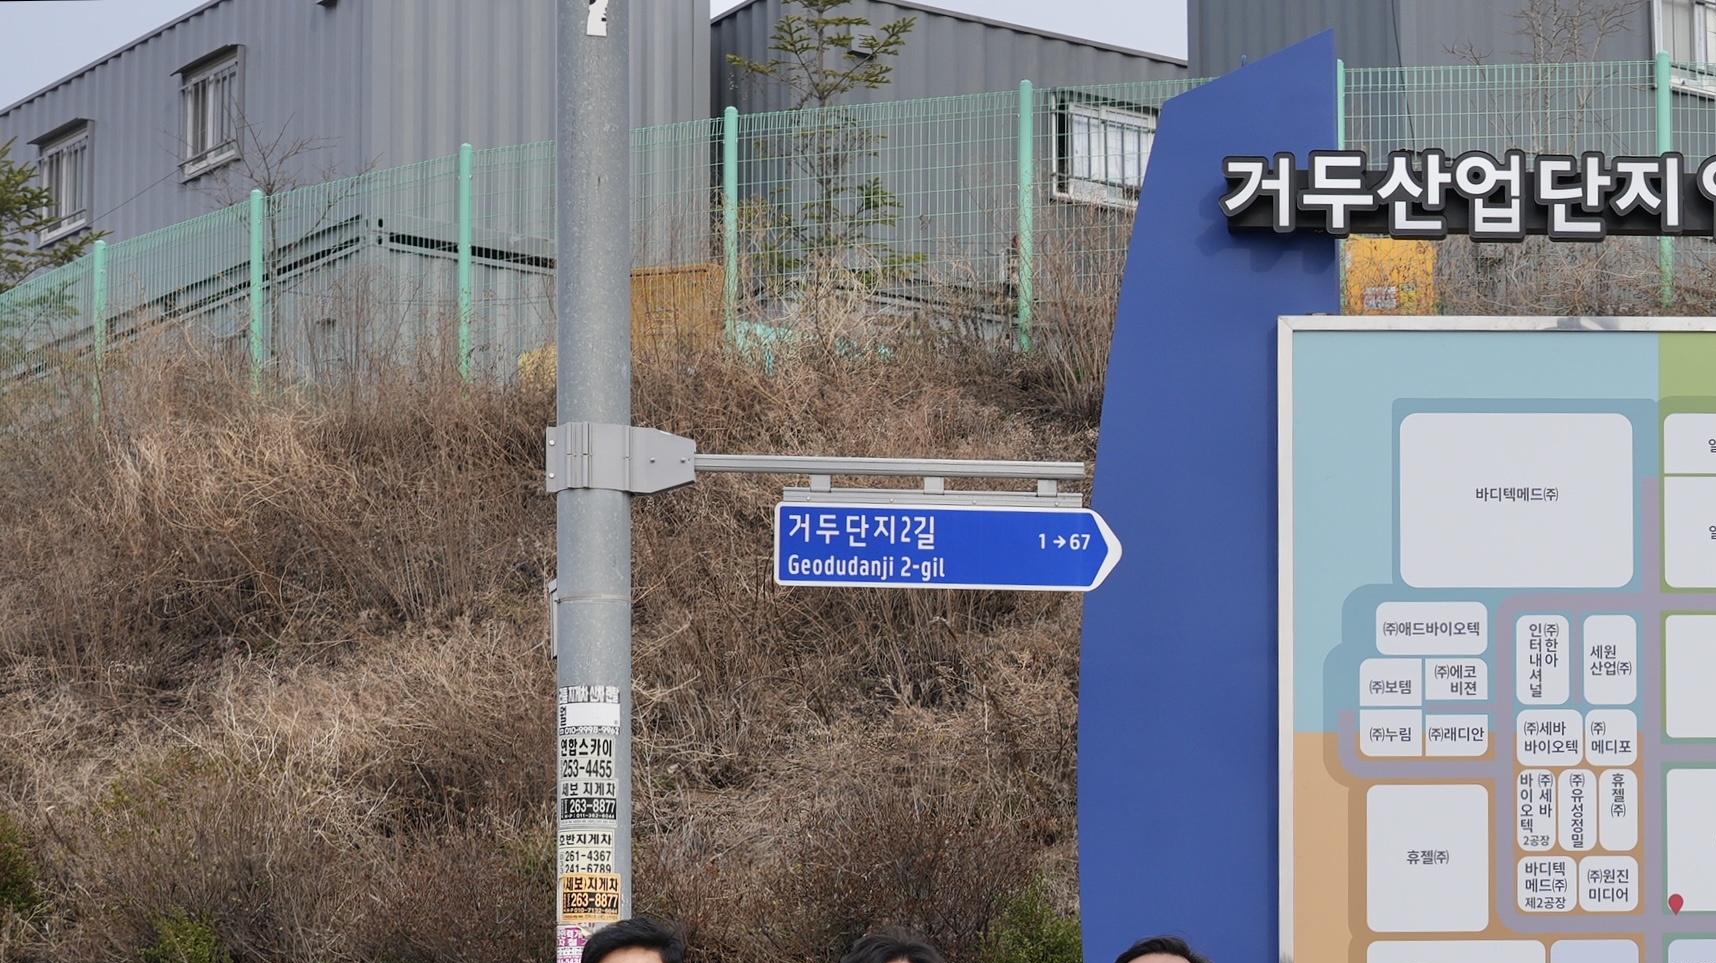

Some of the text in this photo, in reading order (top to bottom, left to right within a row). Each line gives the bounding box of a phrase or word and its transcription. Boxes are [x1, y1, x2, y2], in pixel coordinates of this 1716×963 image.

[1224, 153, 1682, 235] 거두산업단지
[788, 513, 935, 550] 거두단지2길
[1069, 533, 1091, 551] 67
[788, 554, 945, 581] Geodudanji 2-gil
[1590, 644, 1617, 659] 세원
[1450, 681, 1477, 696] 비젼
[560, 738, 612, 757] 연합스카이
[1524, 739, 1578, 755] 바이오텍
[1591, 739, 1632, 755] 메디포
[563, 759, 612, 778] 253-4455
[583, 782, 615, 797] 지게차
[569, 799, 616, 813] 263-8877
[559, 834, 612, 847] 호반지게차
[1523, 834, 1550, 847] 2공장
[565, 850, 612, 862] 261-4367
[1524, 861, 1566, 876] 바디텍
[571, 893, 619, 908] 263-8877
[1588, 887, 1629, 903] 미디어
[1524, 897, 1567, 910] 제2공장
